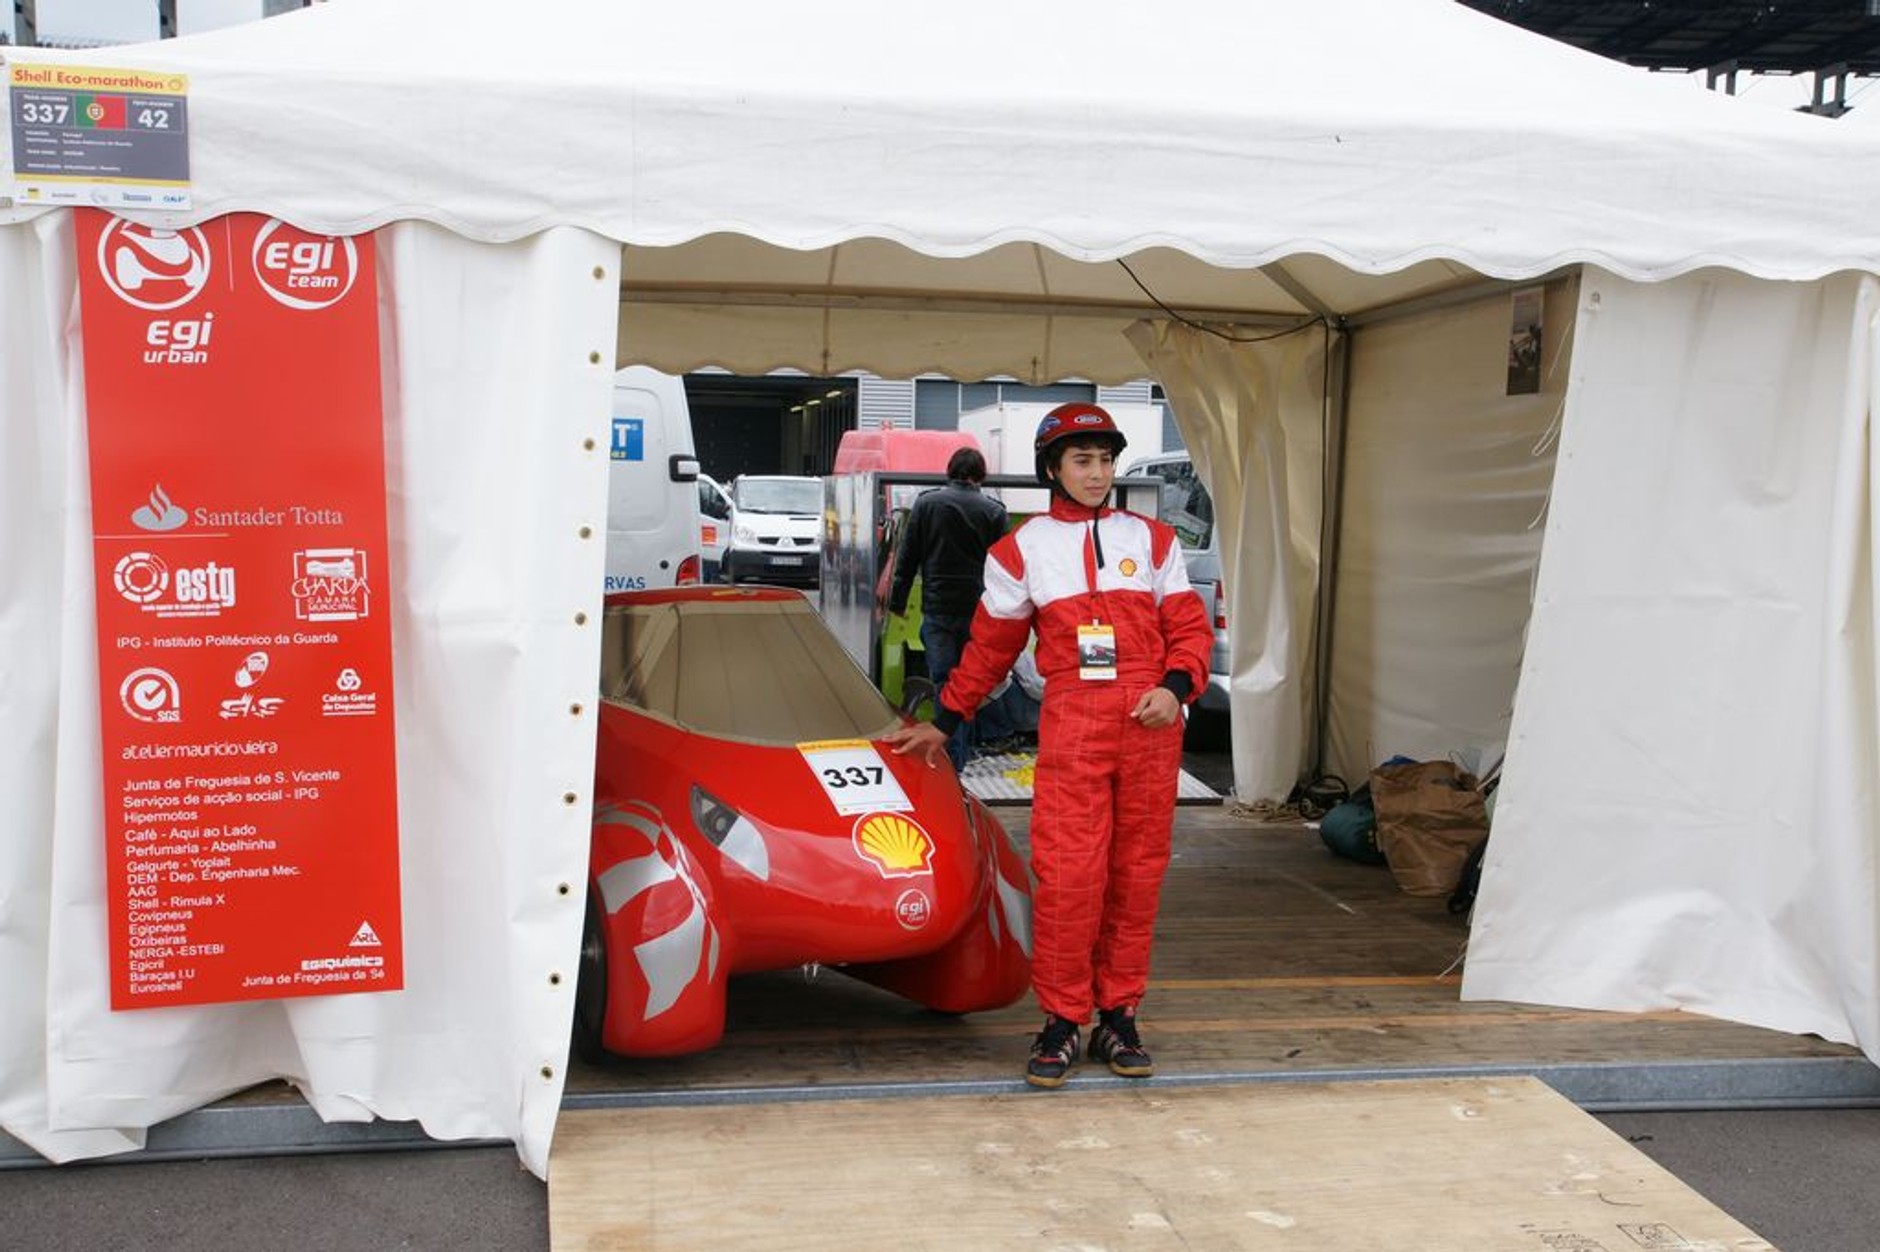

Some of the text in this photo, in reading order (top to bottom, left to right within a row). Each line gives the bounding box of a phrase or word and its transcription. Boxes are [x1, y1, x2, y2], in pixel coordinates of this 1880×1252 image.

[14, 70, 164, 90] Shell Eco-marathon
[23, 103, 68, 124] 337
[138, 110, 169, 128] 42
[288, 274, 338, 288] team
[144, 349, 208, 363] urban
[194, 506, 342, 526] Santader Totta
[176, 562, 236, 607] estg
[117, 637, 140, 648] IPG
[153, 637, 202, 648] Instituto
[206, 634, 271, 646] Politécnico
[274, 634, 290, 644] da
[293, 632, 338, 644] Guarda
[123, 770, 340, 791] Junta de Freguesia de S. Vicente
[823, 767, 883, 788] 337
[123, 796, 180, 808] Serviços
[183, 794, 199, 805] de
[246, 790, 282, 801] social
[294, 788, 319, 800] IPG
[124, 811, 197, 824] Hipermotos
[169, 827, 200, 840] Aqui
[204, 828, 220, 838] ao
[224, 824, 256, 836] Lado
[126, 843, 199, 857] Perfumaria
[211, 839, 276, 852] Abelhinha
[191, 857, 230, 869] Yoplait
[127, 873, 158, 885] DEM
[169, 871, 198, 883] Dep.
[202, 867, 269, 882] Engenharia
[128, 885, 157, 897] AAG
[128, 898, 159, 909] Shell
[170, 896, 212, 907] Rimula
[216, 894, 225, 904] X
[129, 947, 174, 959] NERGA
[242, 975, 273, 987] Junta
[276, 974, 291, 984] de
[294, 971, 349, 984] Freguesia
[130, 981, 182, 994] Euroshell
